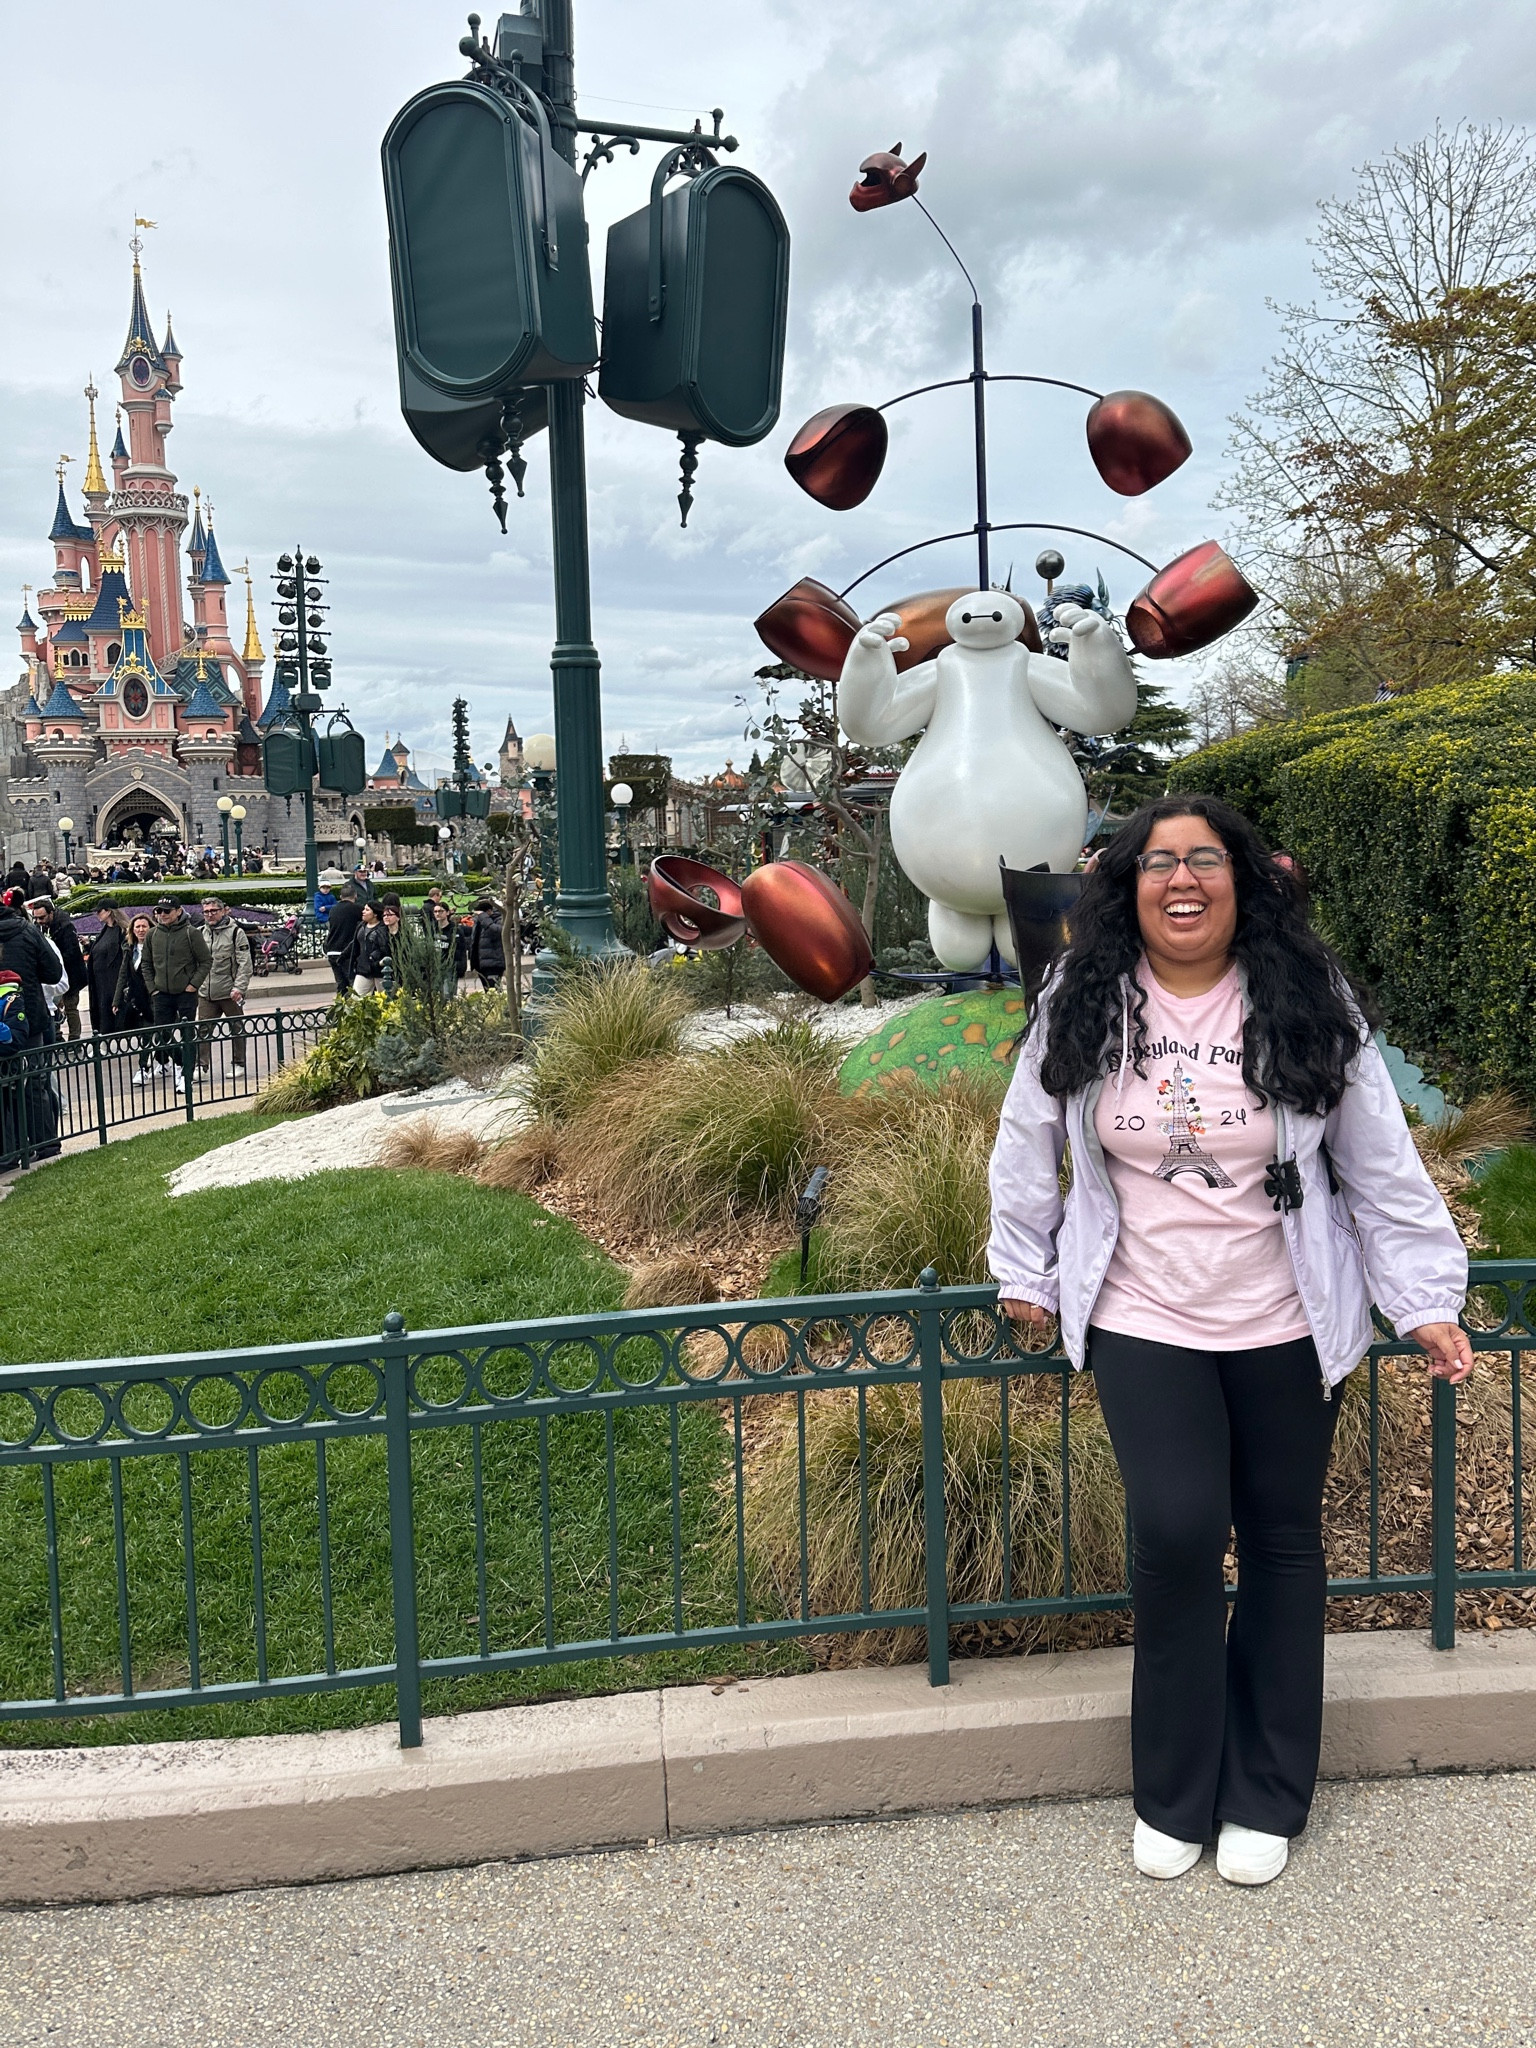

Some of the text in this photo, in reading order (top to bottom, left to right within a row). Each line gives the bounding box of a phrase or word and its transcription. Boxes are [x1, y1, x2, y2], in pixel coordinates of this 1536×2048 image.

[1207, 1043, 1244, 1066] Par
[1114, 1108, 1247, 1132] 20 24
